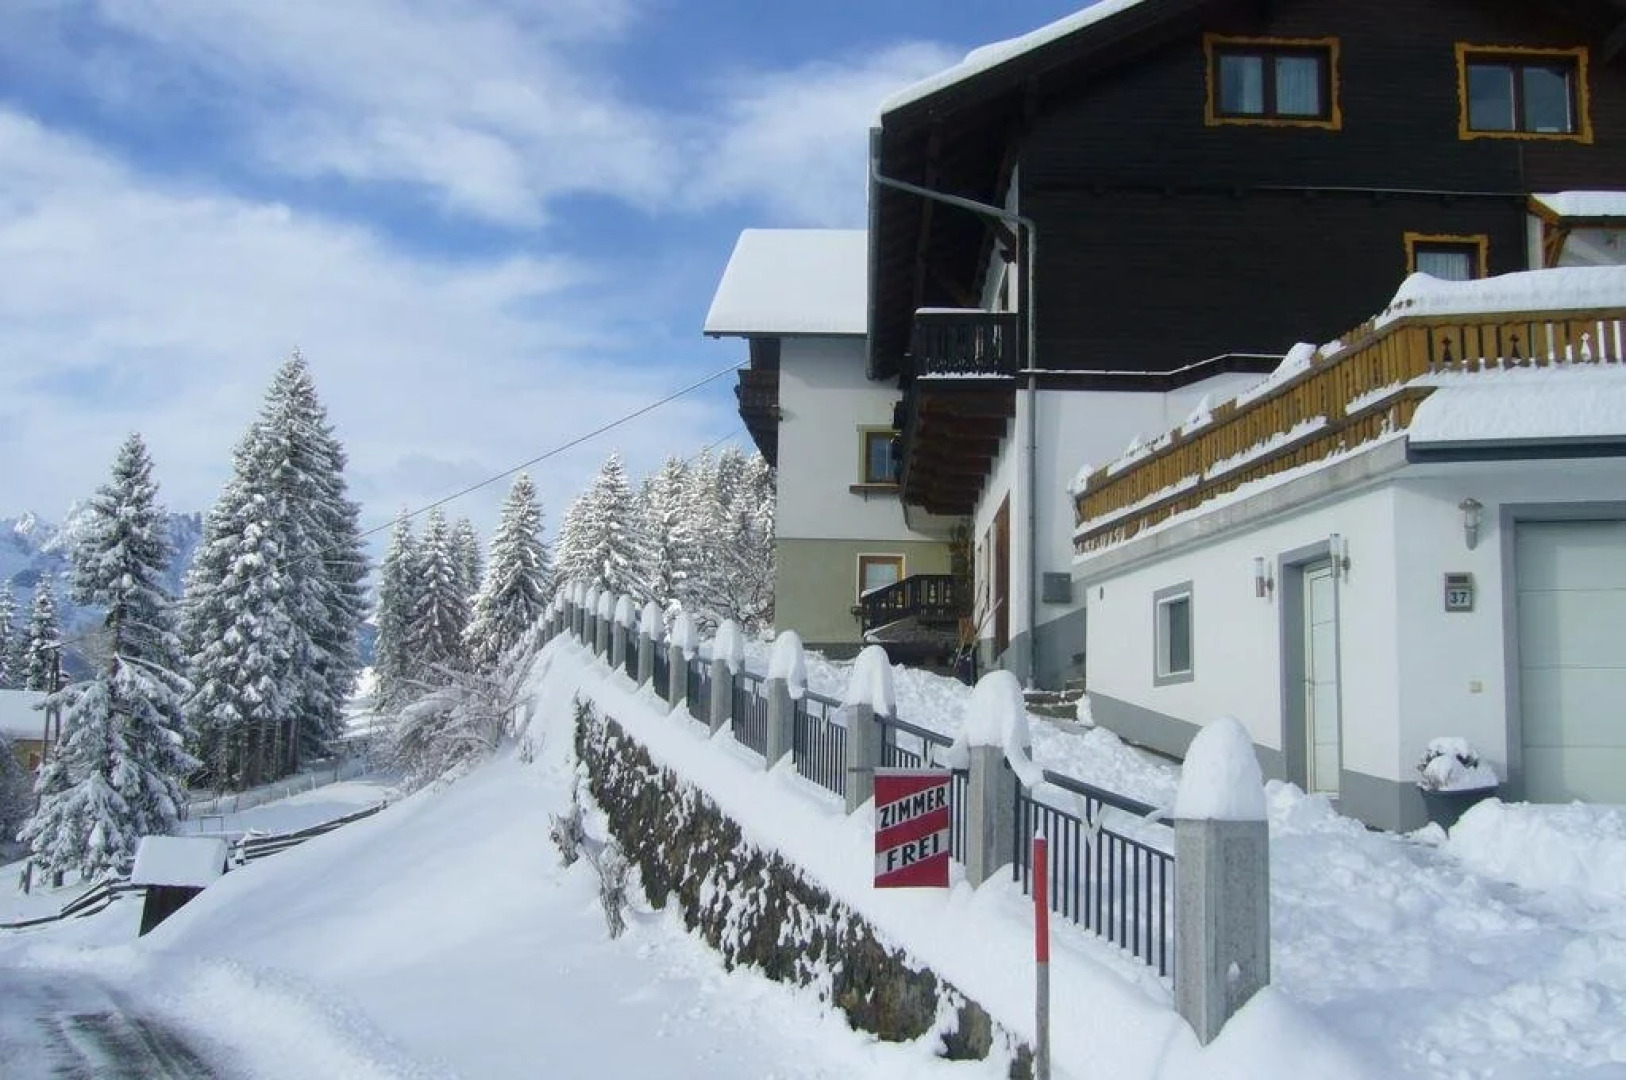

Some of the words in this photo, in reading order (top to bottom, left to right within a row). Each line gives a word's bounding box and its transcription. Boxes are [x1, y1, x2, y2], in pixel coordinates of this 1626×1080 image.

[1449, 591, 1467, 604] 37
[880, 786, 946, 828] ZIMMER
[887, 833, 939, 872] FREI
